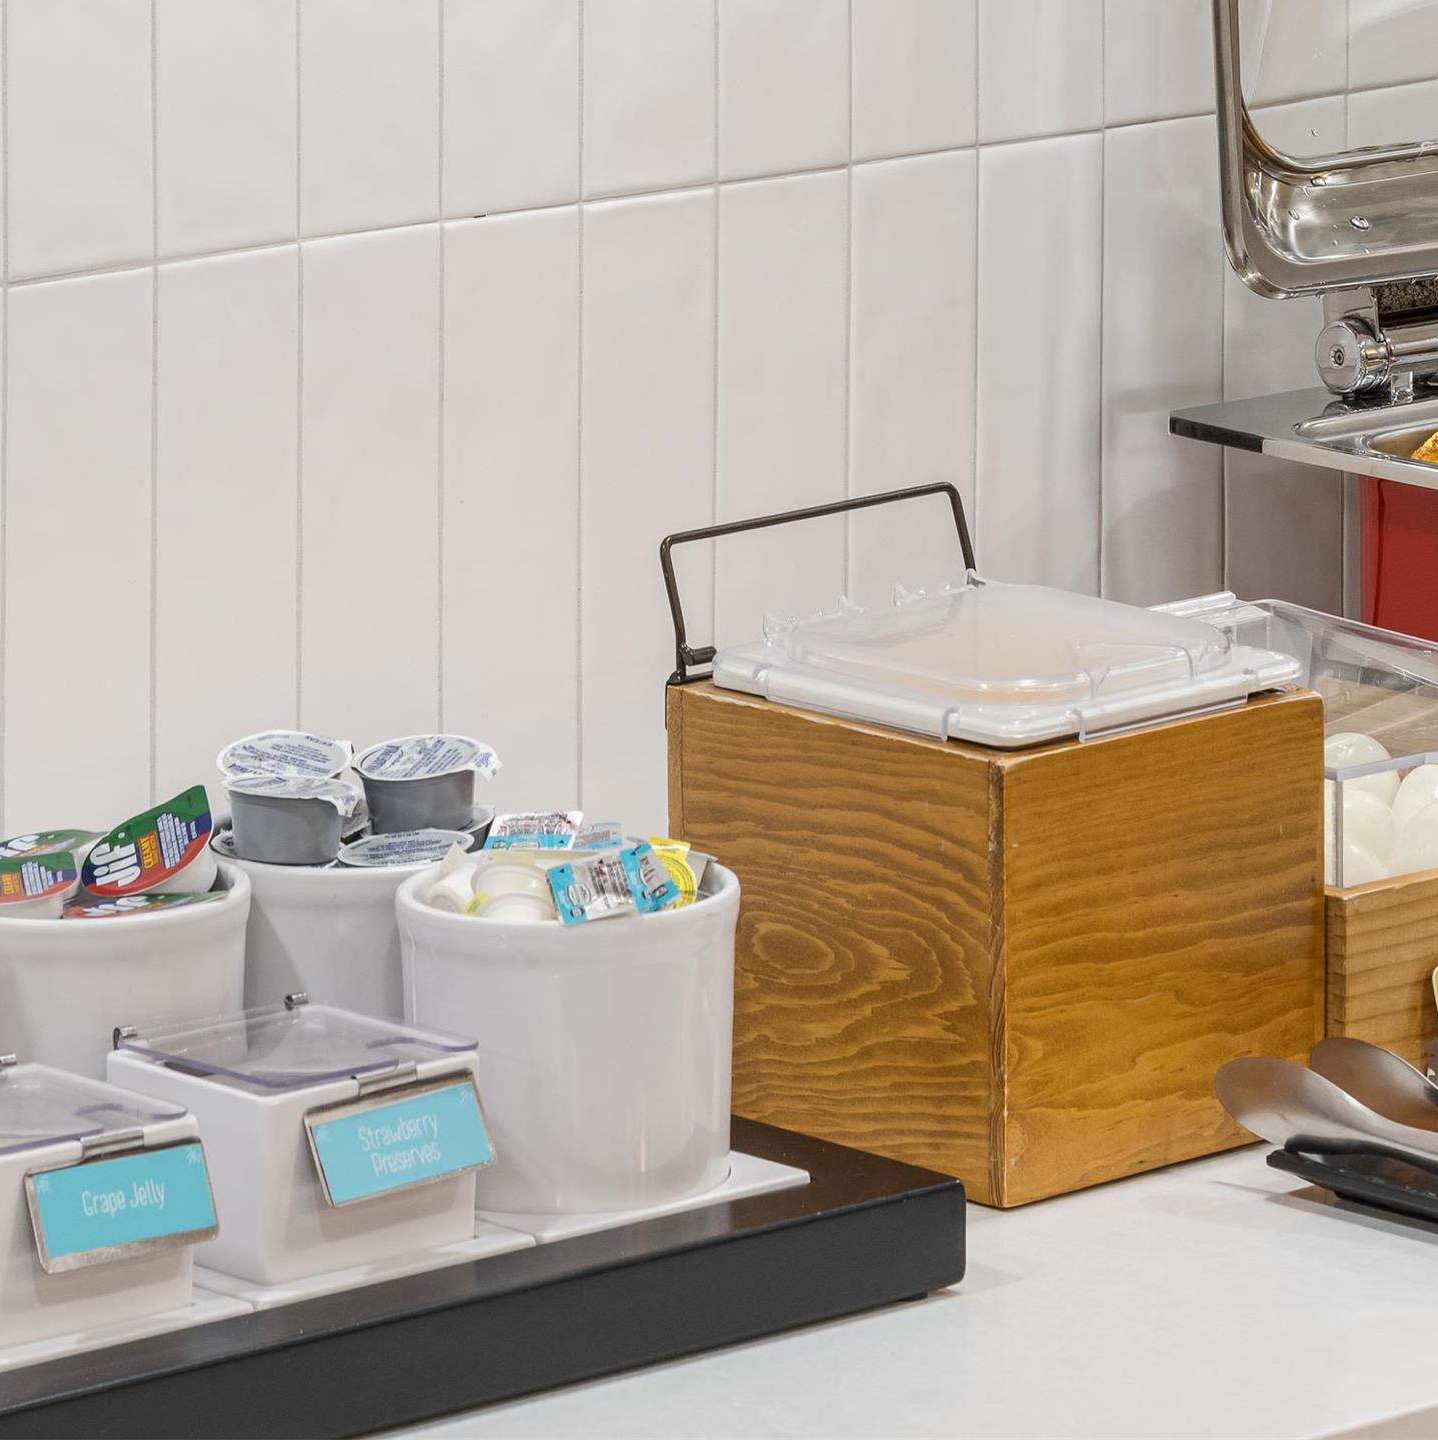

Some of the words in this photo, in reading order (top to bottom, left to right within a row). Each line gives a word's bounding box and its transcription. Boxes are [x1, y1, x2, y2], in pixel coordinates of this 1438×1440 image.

[357, 1112, 439, 1152] Strawberry
[370, 1141, 442, 1178] Preserves
[81, 1189, 127, 1218] Grape
[130, 1178, 166, 1210] Jelly
